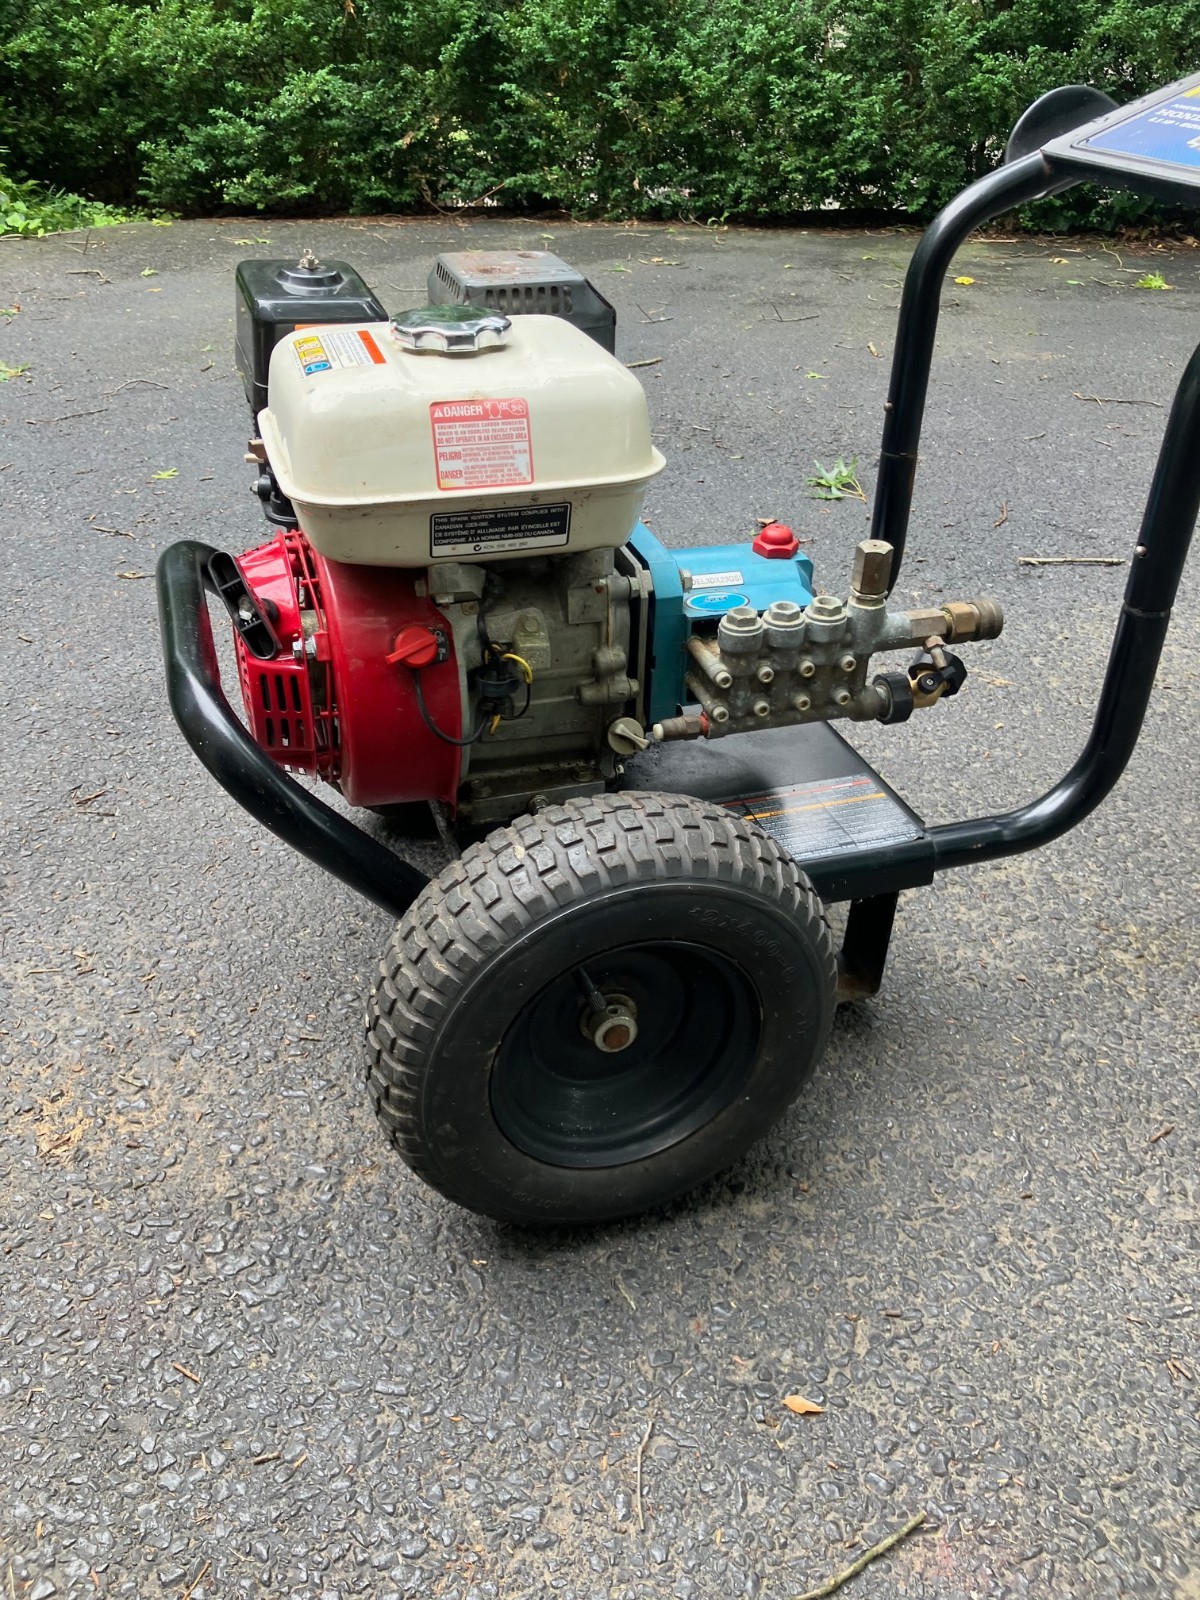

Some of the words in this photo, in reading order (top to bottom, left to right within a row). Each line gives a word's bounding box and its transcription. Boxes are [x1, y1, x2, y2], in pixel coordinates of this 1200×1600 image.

[443, 405, 483, 417] DANGER
[437, 436, 444, 444] DO
[445, 436, 454, 444] NOT
[455, 435, 476, 443] OPERATE
[490, 433, 514, 441] ENCLOSED
[515, 431, 527, 439] AREA
[438, 450, 462, 461] PELIGRO
[440, 469, 464, 480] DANGER
[521, 508, 548, 516] COMPLIES
